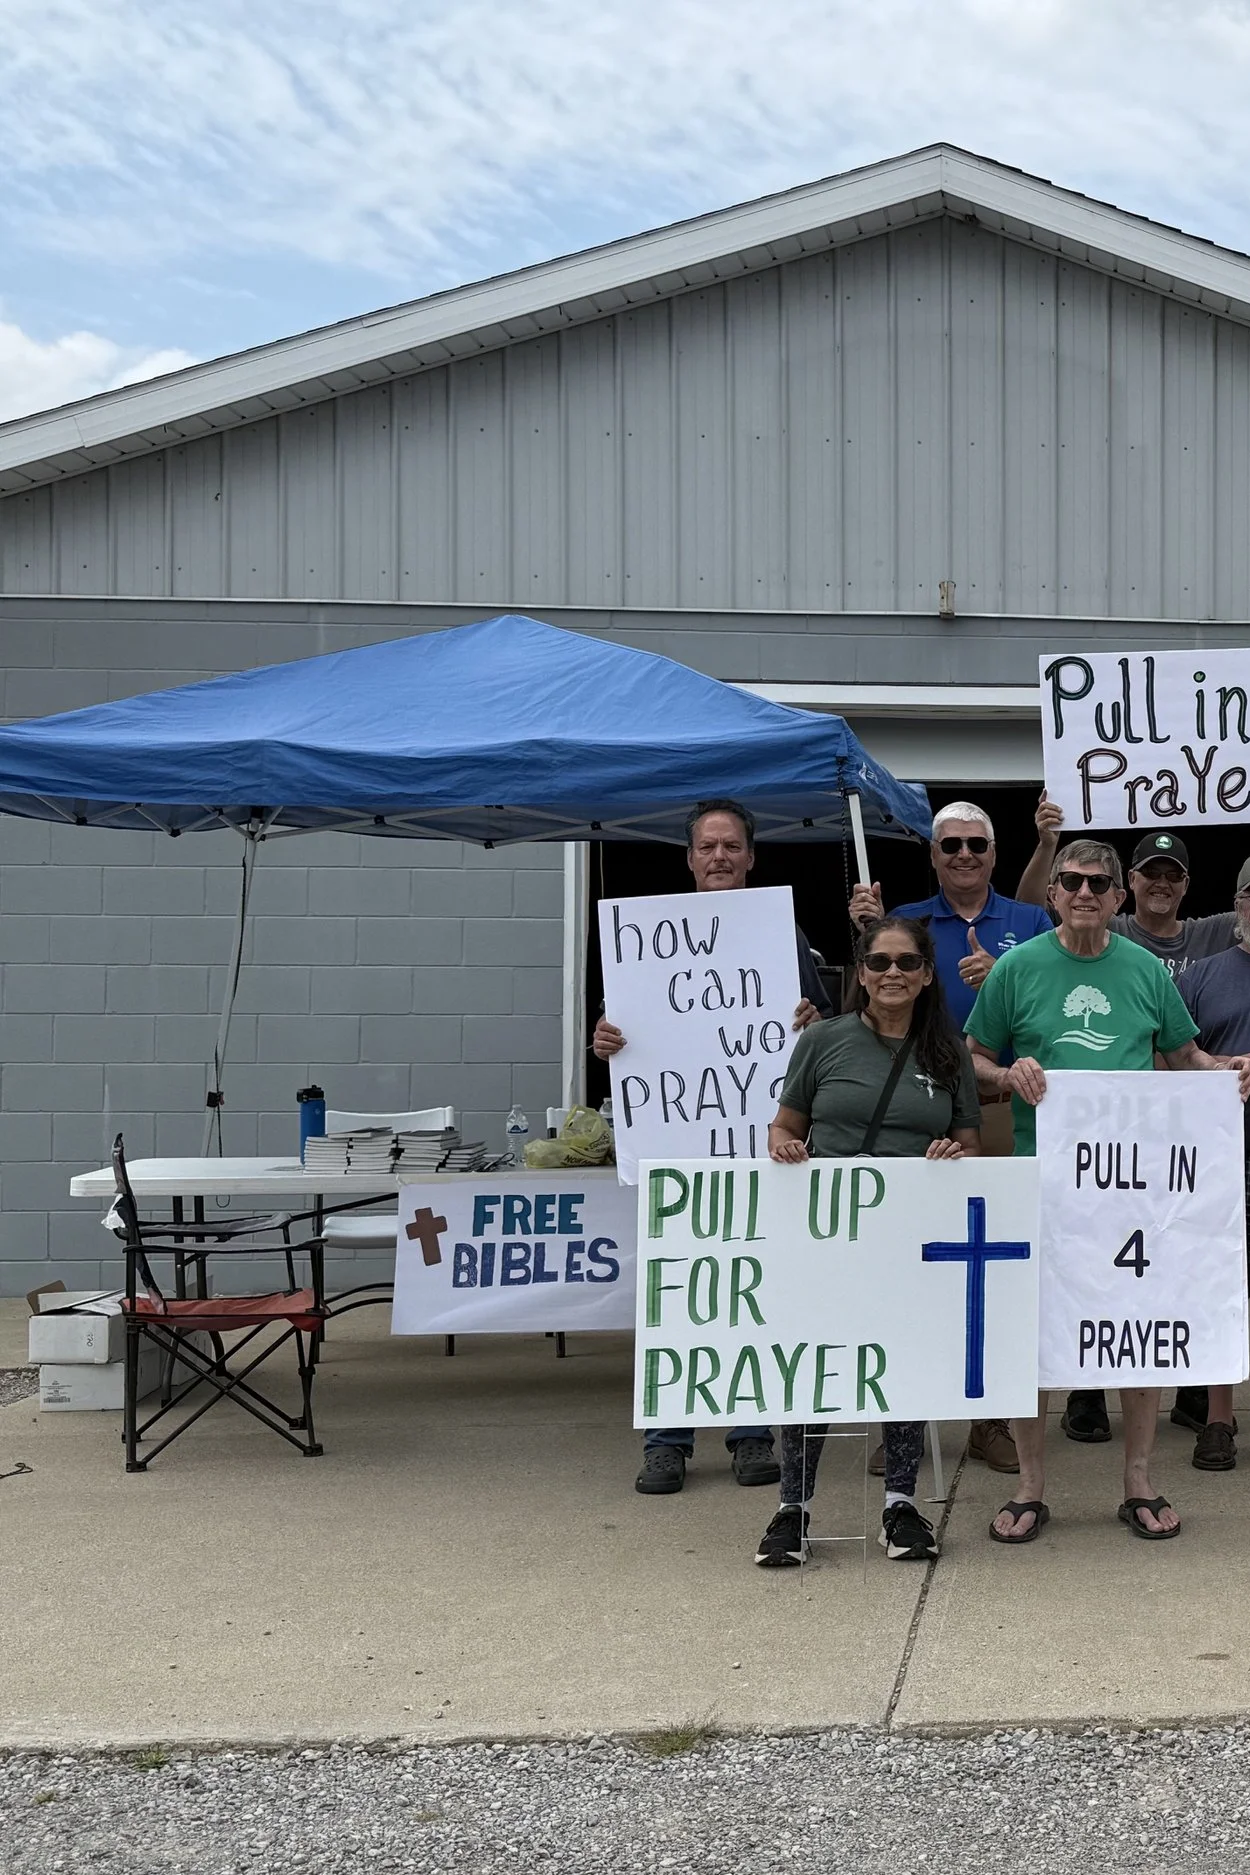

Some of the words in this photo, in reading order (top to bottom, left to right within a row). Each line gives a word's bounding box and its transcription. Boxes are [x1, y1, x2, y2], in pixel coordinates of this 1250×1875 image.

[1045, 656, 1171, 744] Pull
[1192, 670, 1250, 744] in
[612, 905, 719, 963] how
[668, 968, 764, 1013] can
[718, 1020, 786, 1058] we
[1076, 1142, 1147, 1190] PULL
[1168, 1144, 1197, 1193] IN
[472, 1193, 584, 1237] FREE
[648, 1167, 766, 1242] PULL
[808, 1166, 886, 1242] UP
[452, 1237, 620, 1288] BIBLES
[1114, 1229, 1150, 1278] 4
[646, 1255, 767, 1328] FOR
[1079, 1319, 1190, 1369] PRAYER
[643, 1343, 890, 1417] PRAYER
